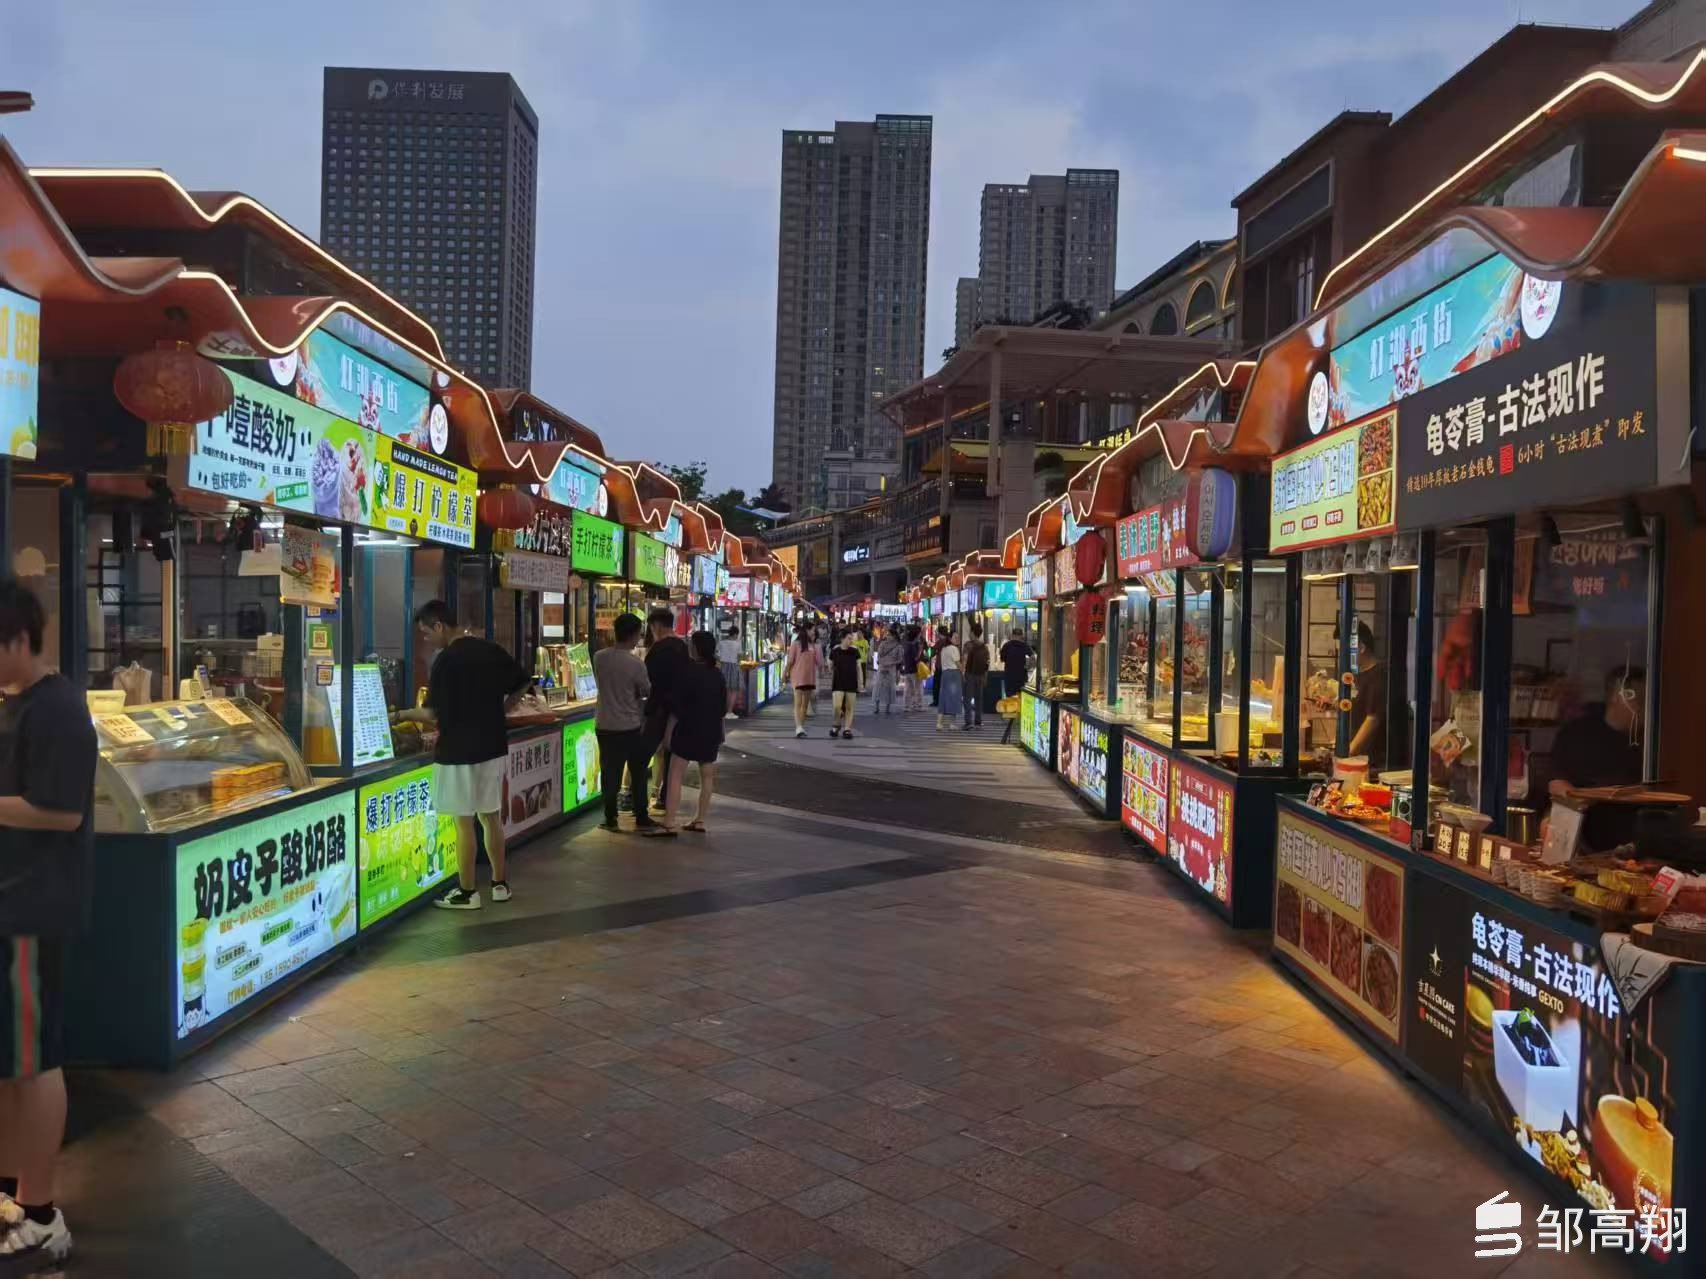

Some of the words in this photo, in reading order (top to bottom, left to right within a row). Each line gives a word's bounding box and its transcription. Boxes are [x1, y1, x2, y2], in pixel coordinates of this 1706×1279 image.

[392, 80, 465, 100] 保利发展
[1426, 352, 1606, 457] 龟苓膏-古法现作
[393, 448, 410, 463] HAND
[411, 455, 428, 470] MADE
[1517, 440, 1545, 464] 6小时
[1616, 410, 1646, 441] 即发
[393, 471, 473, 528] 爆打柠檬茶
[366, 780, 431, 836] 爆打柠檬茶
[194, 812, 347, 921] 奶皮子酸奶酪
[1279, 824, 1363, 912] 韩国辣炒鸡脚
[1471, 911, 1622, 1019] 龟苓膏-古法现作
[1538, 990, 1564, 1014] GEXTO
